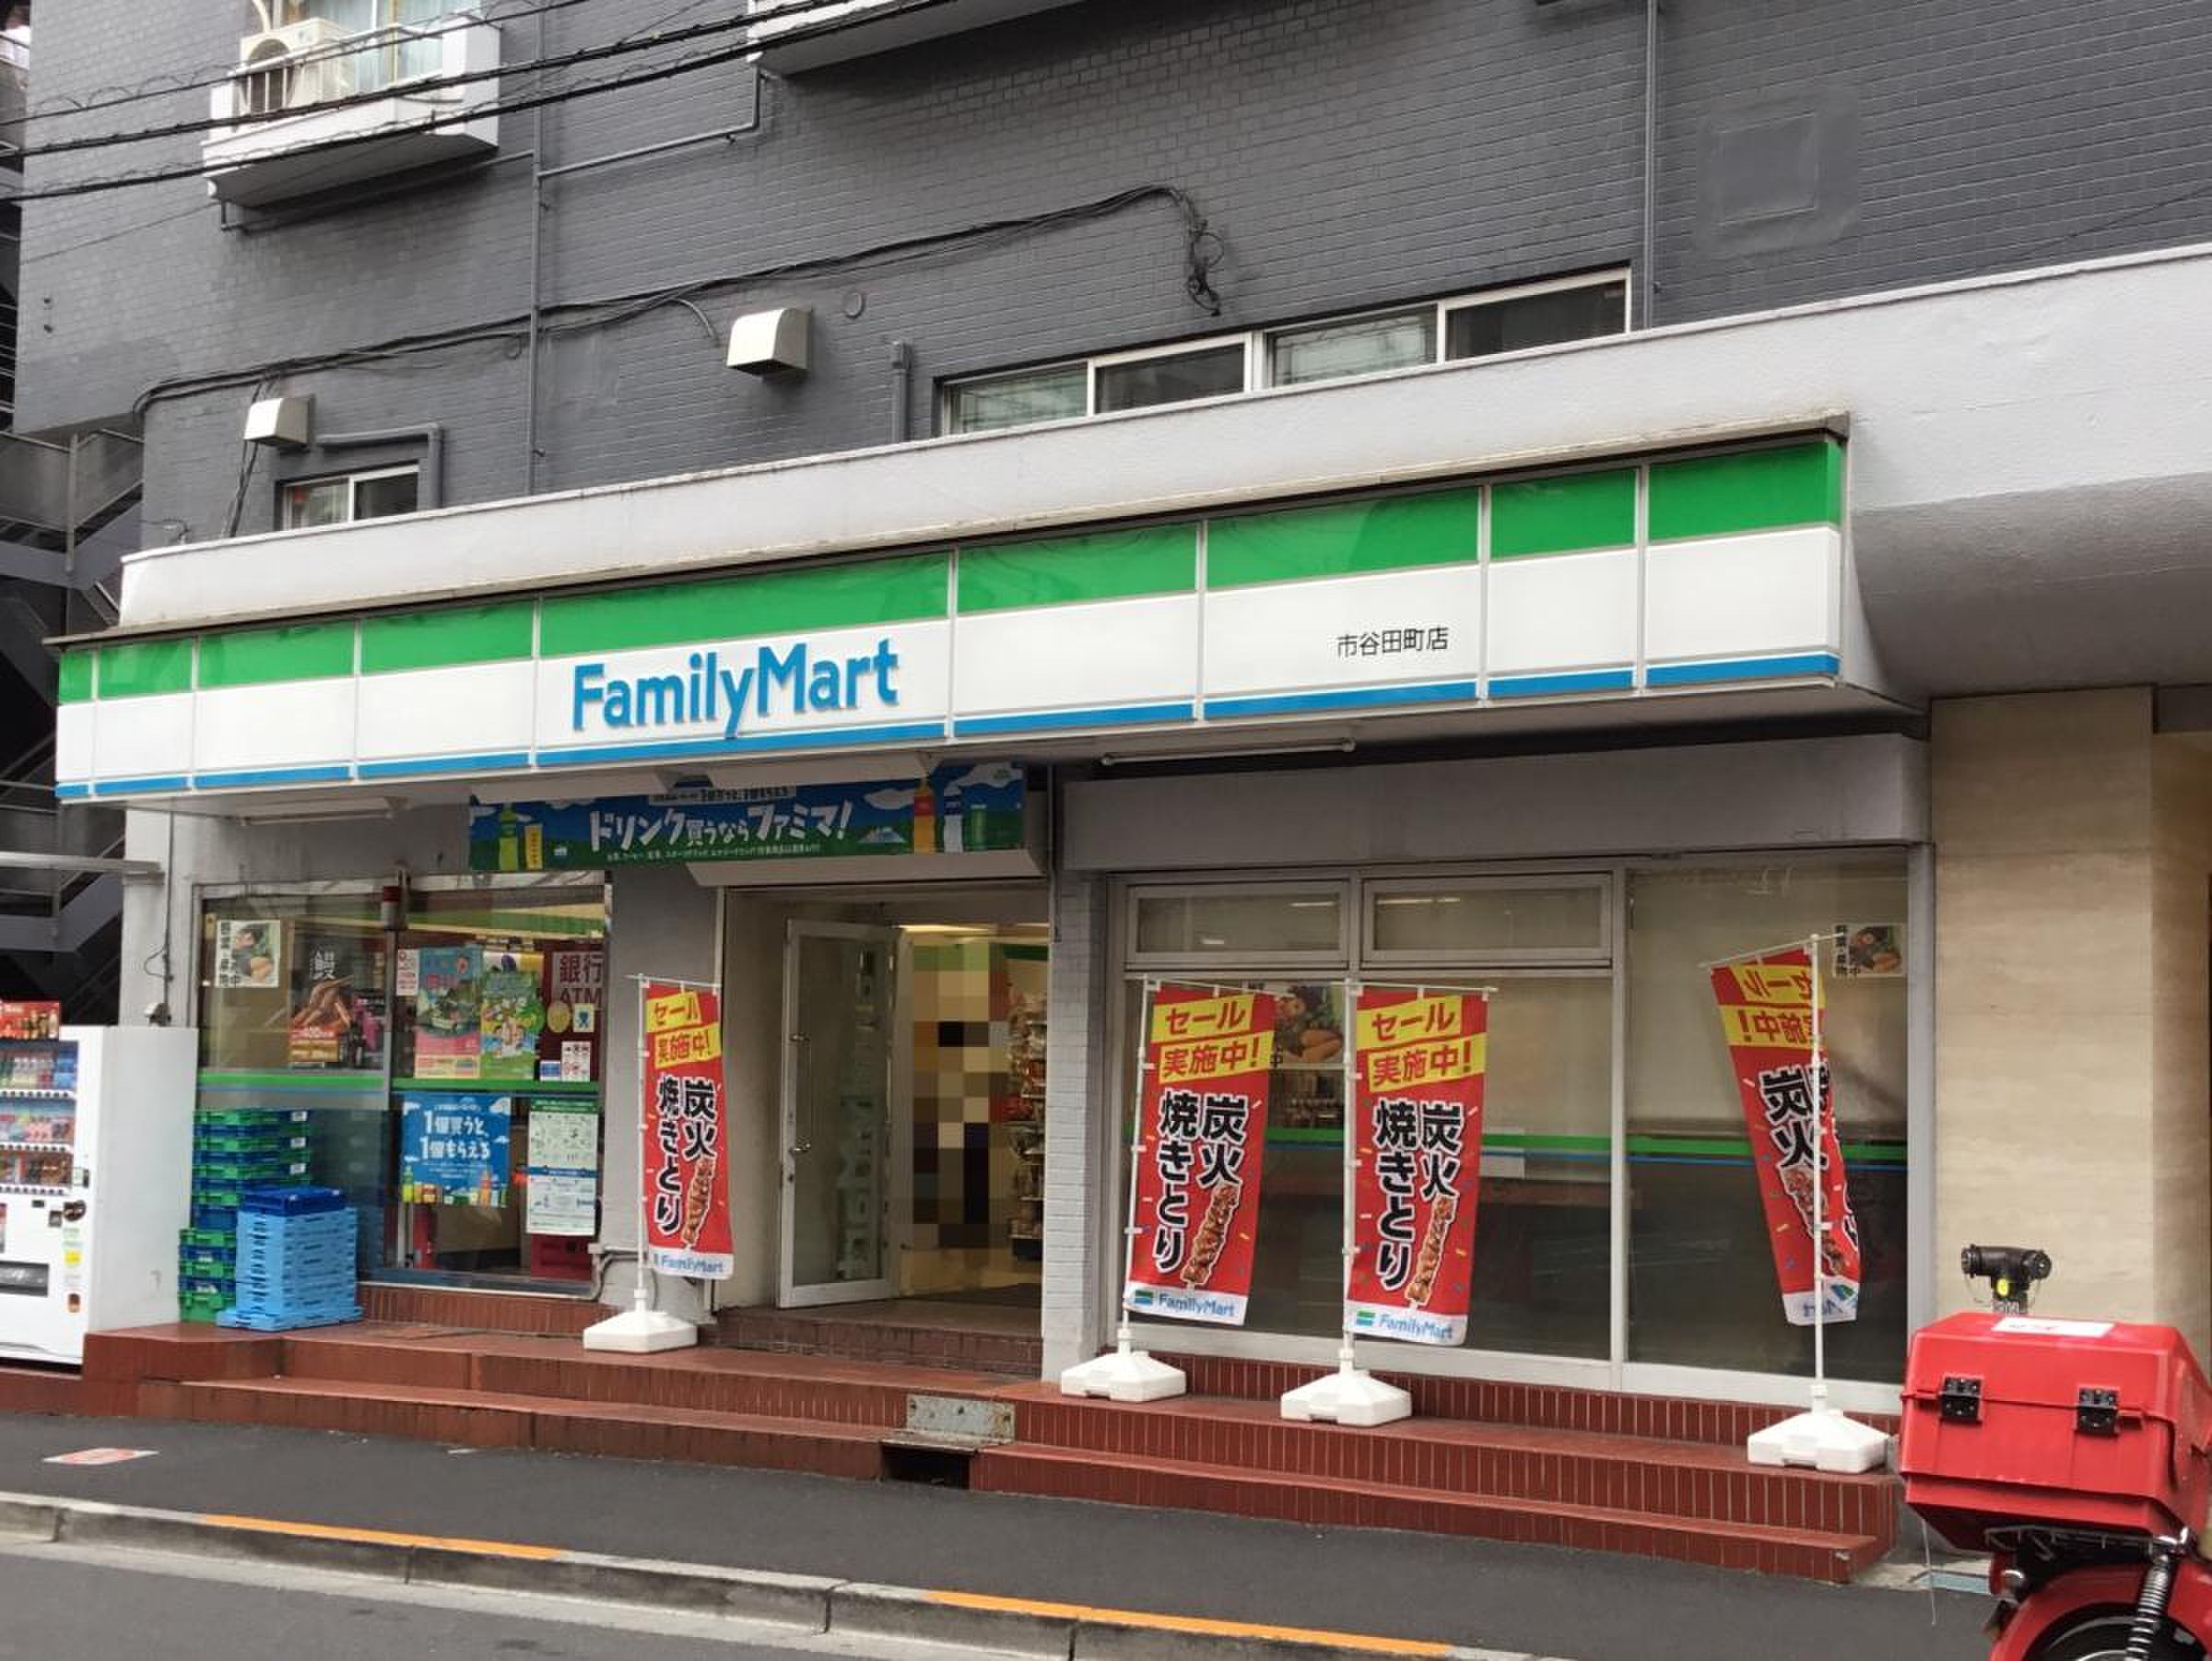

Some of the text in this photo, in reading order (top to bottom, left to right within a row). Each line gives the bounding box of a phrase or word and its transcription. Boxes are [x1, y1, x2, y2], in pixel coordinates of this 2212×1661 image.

[1336, 626, 1449, 658] 市谷田町店
[571, 638, 900, 739] FamilyMart
[559, 953, 604, 984] 銀行
[559, 988, 603, 1008] ATM
[1166, 1002, 1247, 1035] セール
[1371, 1001, 1455, 1042] セール
[1163, 1042, 1260, 1074] 実施中!
[1372, 1045, 1473, 1084] 実施中!
[684, 1079, 716, 1160] 炭火
[656, 1076, 679, 1232] 焼きとり
[1198, 1095, 1246, 1188] 炭火
[1419, 1102, 1464, 1199] 炭火
[1155, 1090, 1199, 1271] 焼きとり
[1374, 1098, 1418, 1290] 焼きとり
[661, 1254, 724, 1274] FamilyMart
[1159, 1292, 1235, 1318] FamilyMart
[1378, 1313, 1453, 1342] FamilyMart
